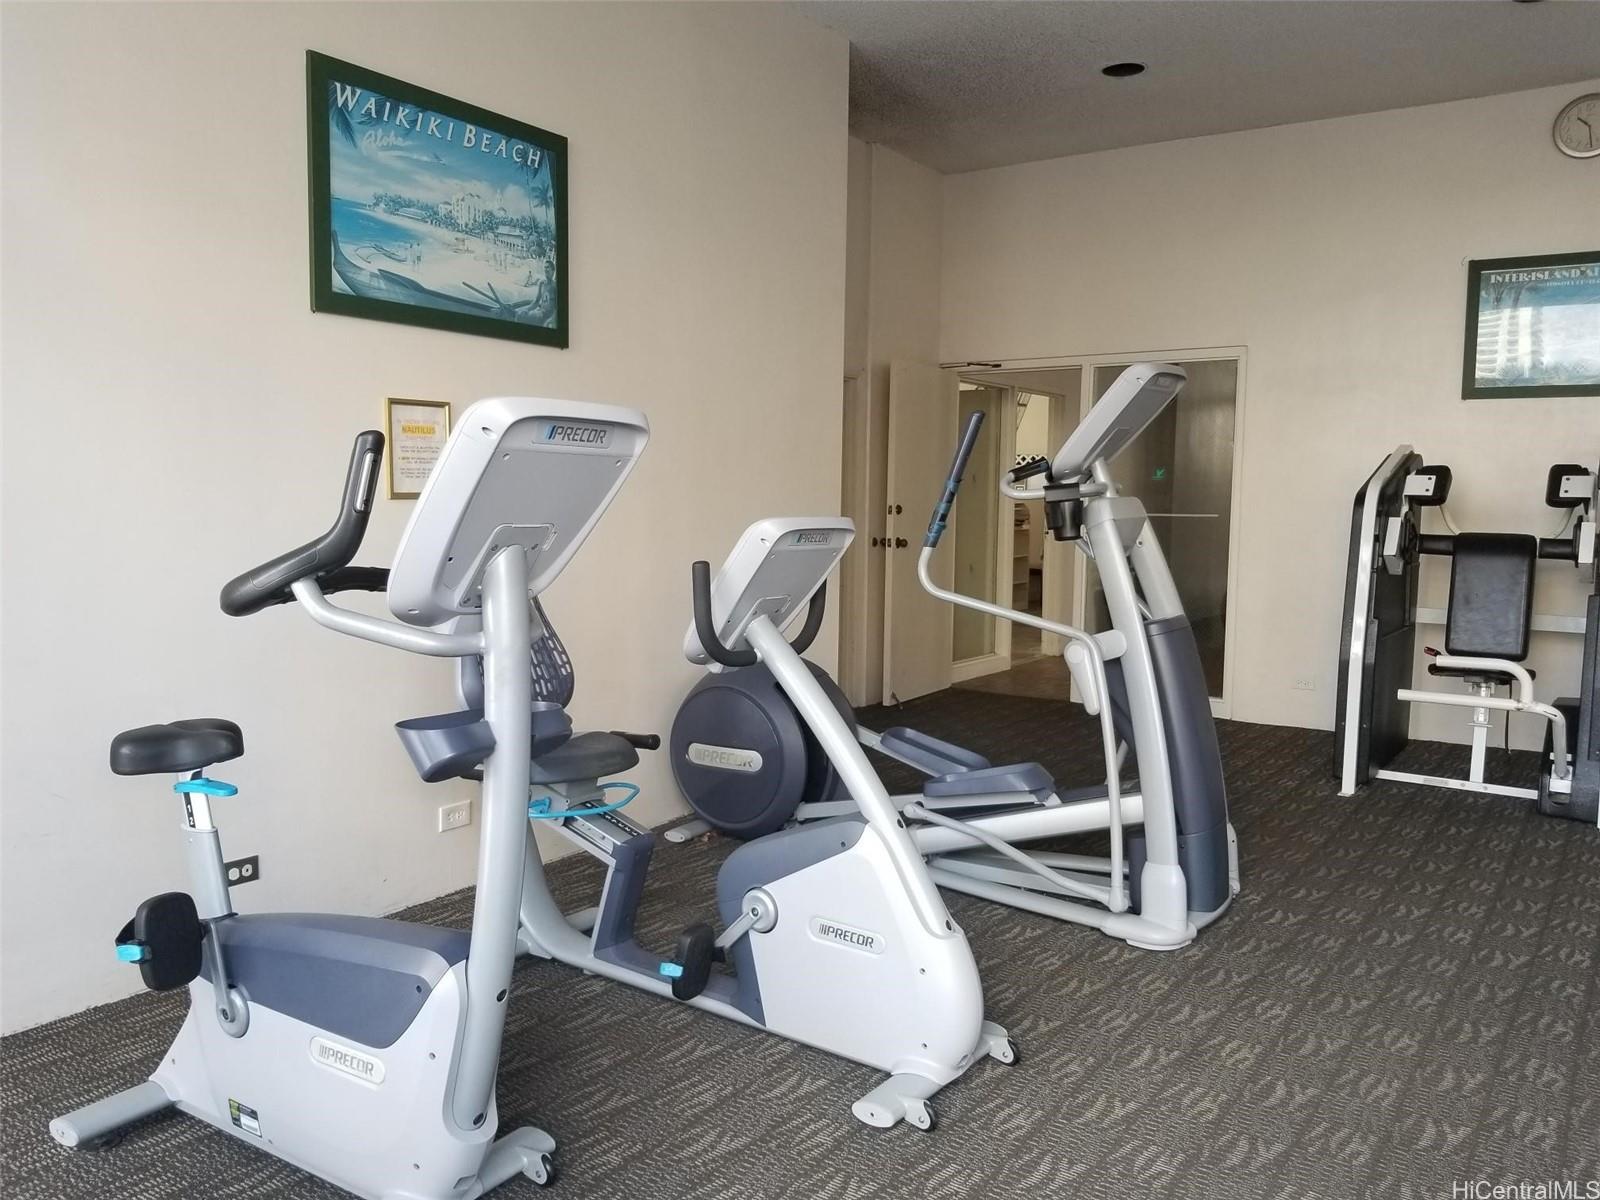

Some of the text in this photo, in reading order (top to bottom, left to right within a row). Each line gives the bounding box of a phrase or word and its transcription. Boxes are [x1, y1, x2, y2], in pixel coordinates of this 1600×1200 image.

[334, 82, 542, 169] WAIKIKI BEACH
[402, 424, 436, 435] NAUTILUS
[550, 425, 607, 443] PRECOR
[823, 924, 874, 949] PRECOR
[323, 1045, 374, 1076] PRECOR
